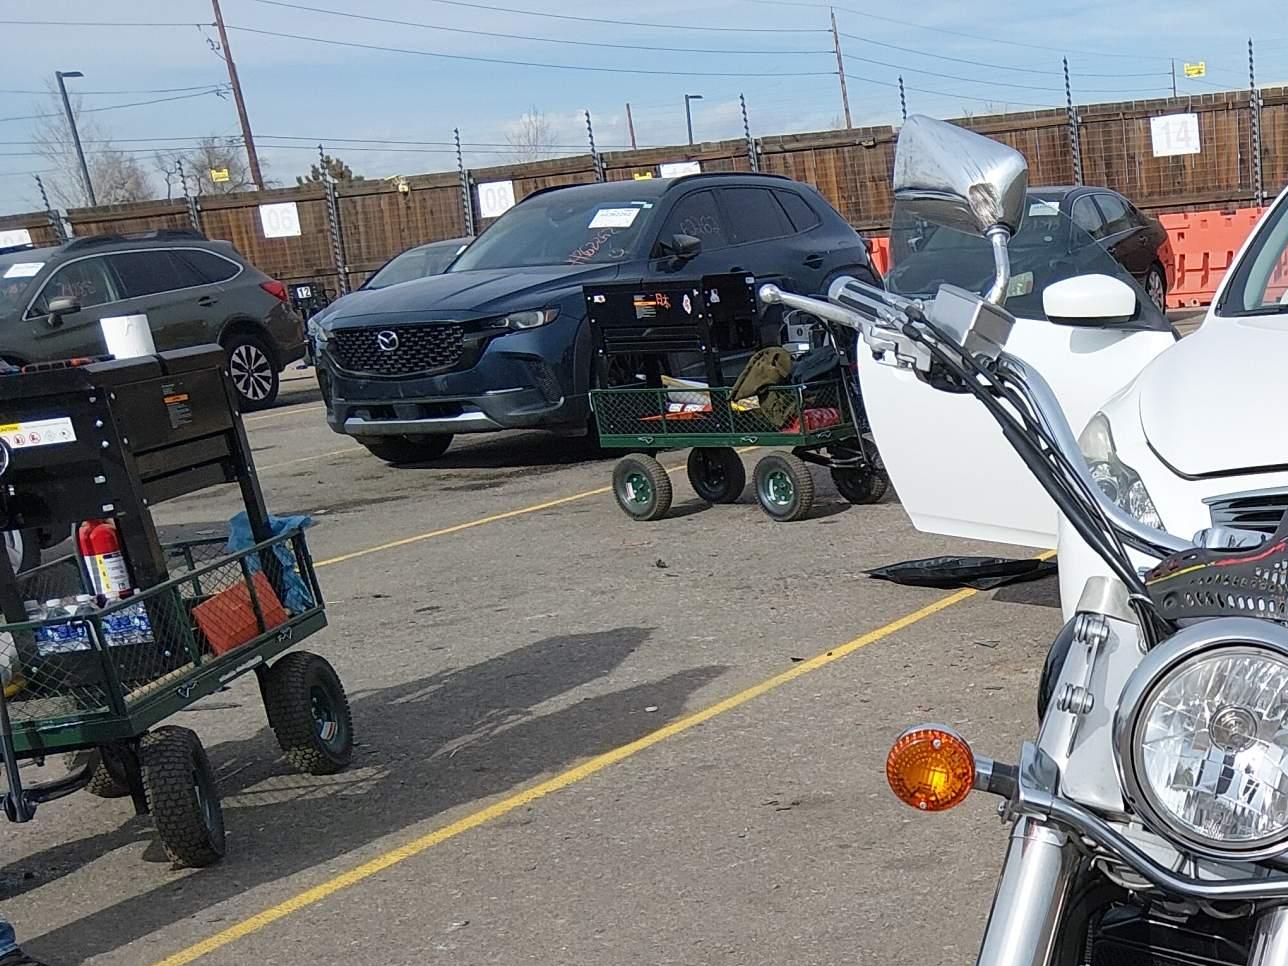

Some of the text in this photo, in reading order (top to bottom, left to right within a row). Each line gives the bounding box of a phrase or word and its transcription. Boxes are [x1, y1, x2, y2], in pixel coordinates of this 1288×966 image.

[1158, 121, 1192, 147] 14
[484, 187, 510, 210] 08
[266, 208, 292, 230] 06
[299, 287, 311, 297] 12
